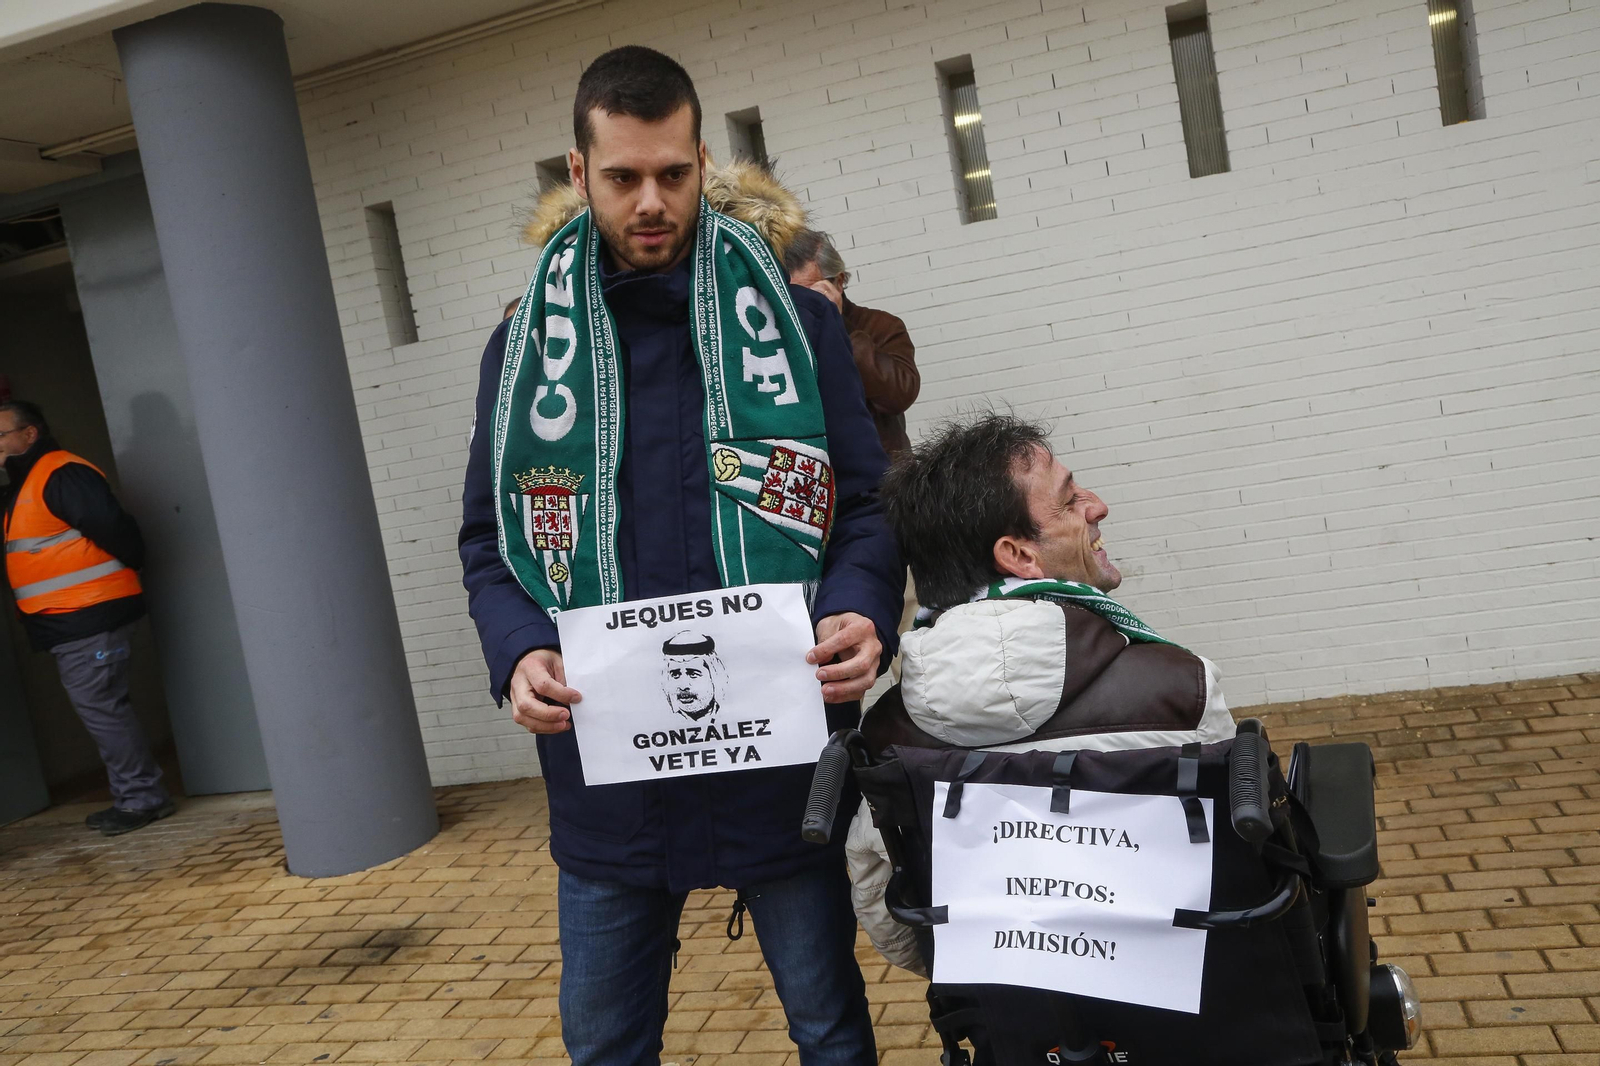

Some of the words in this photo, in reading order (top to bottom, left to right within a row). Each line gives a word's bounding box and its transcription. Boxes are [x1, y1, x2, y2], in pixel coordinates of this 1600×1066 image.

[590, 276, 599, 309] ORGULLO
[708, 300, 715, 312] NO
[709, 312, 719, 340] HABRÁ
[512, 340, 523, 368] HINCHA
[596, 338, 604, 348] DE
[710, 341, 718, 366] RIVAL
[504, 368, 510, 379] TU
[597, 349, 606, 379] BLANCA
[713, 366, 721, 383] QUE
[716, 391, 723, 401] TU
[601, 418, 607, 429] DE
[717, 402, 727, 428] TESÓN
[607, 524, 613, 534] EN
[600, 532, 608, 569] ANCLADA
[607, 535, 617, 589] COMPITIENDO
[603, 570, 611, 598] BARCA
[605, 599, 714, 630] JEQUES
[722, 592, 763, 615] NO
[632, 718, 772, 750] GONZÁLEZ
[649, 749, 718, 772] VETE
[724, 745, 762, 764] YA
[993, 821, 1140, 853] ¡DIRECTIVA,
[1005, 877, 1115, 904] INEPTOS:
[993, 930, 1117, 961] DIMISIÓN!
